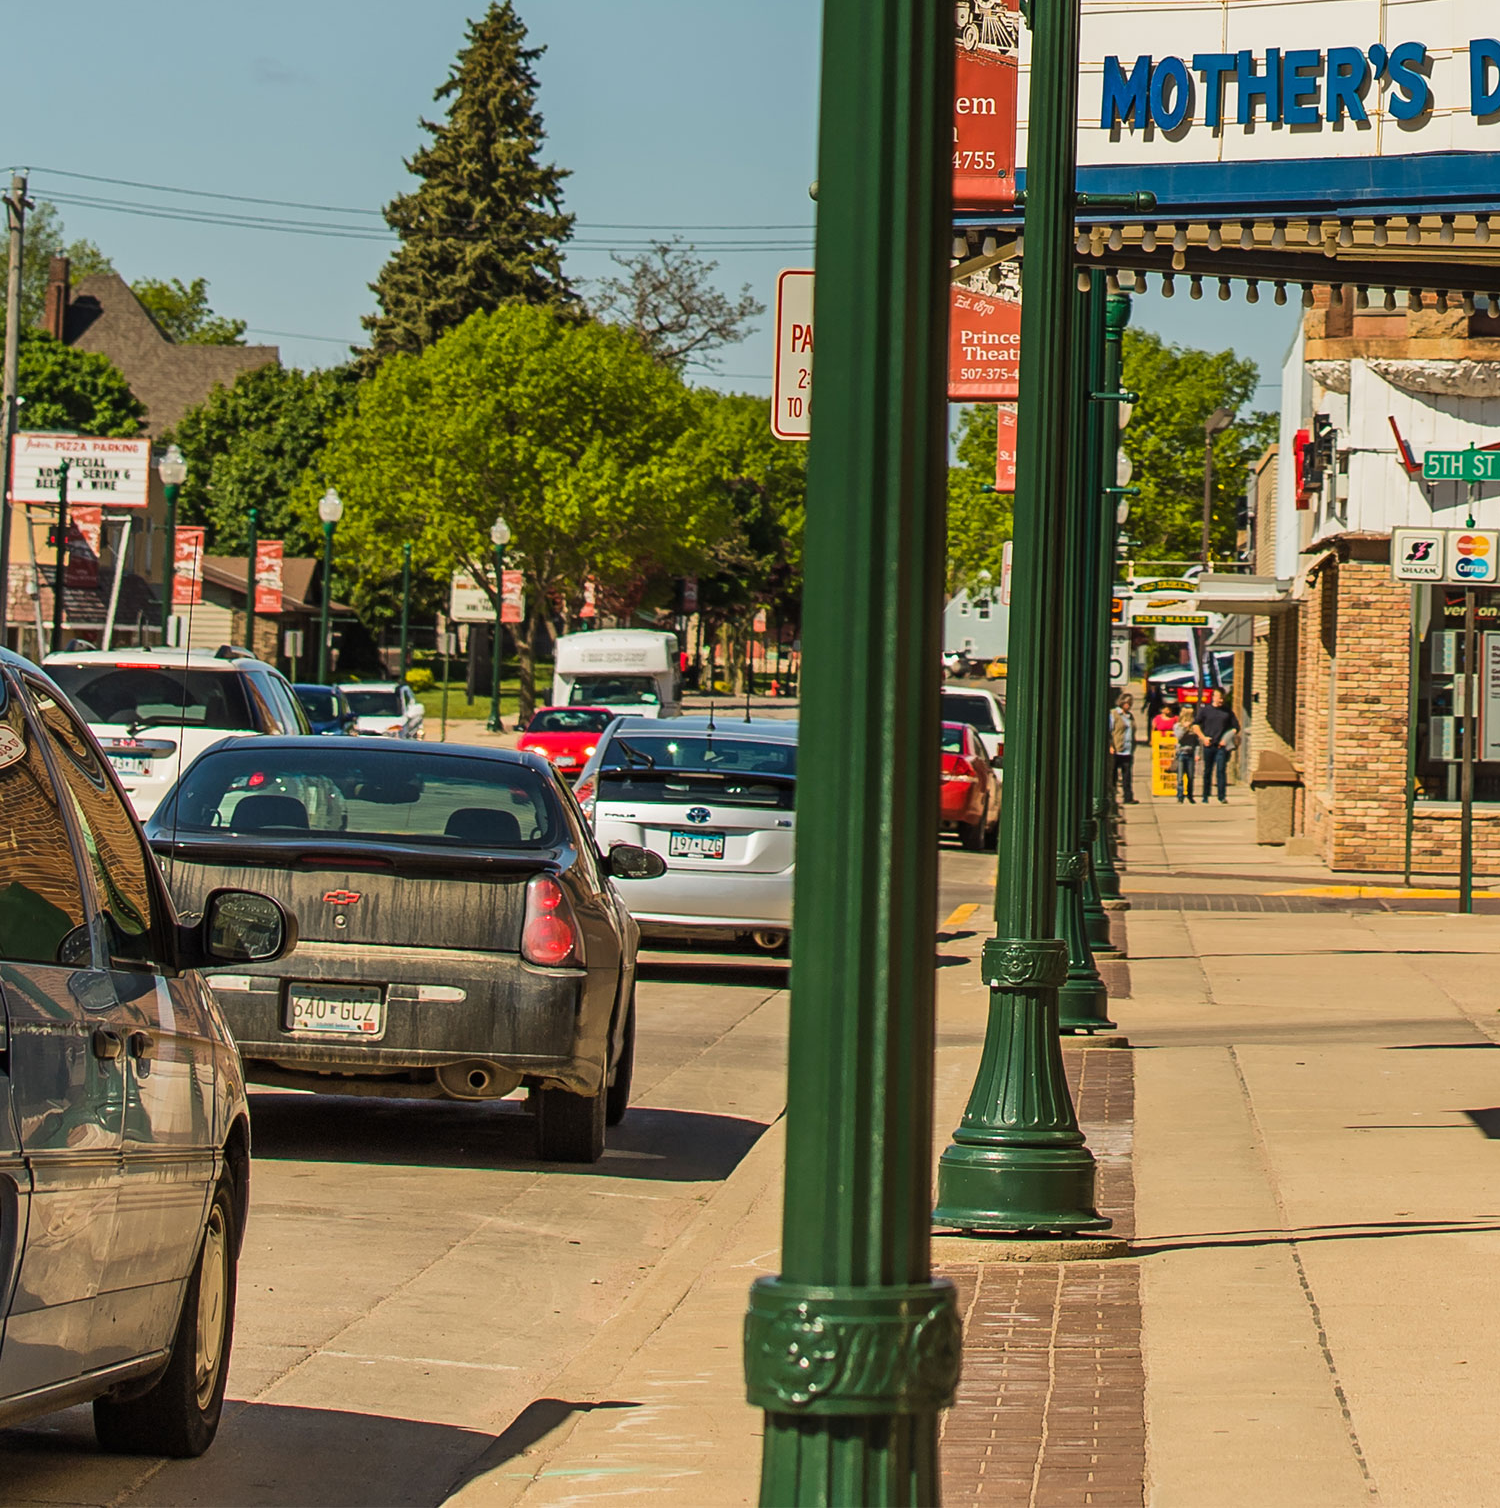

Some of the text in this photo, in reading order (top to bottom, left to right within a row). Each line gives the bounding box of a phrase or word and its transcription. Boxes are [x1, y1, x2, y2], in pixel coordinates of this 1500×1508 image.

[1100, 42, 1430, 132] MOTHER'S
[787, 396, 802, 417] TO
[54, 441, 88, 452] PIZZA
[92, 443, 139, 453] PARKING
[1428, 454, 1464, 476] 5TH
[1472, 454, 1495, 477] ST
[1401, 567, 1438, 575] SHAZAM
[1457, 562, 1488, 574] Cirrus
